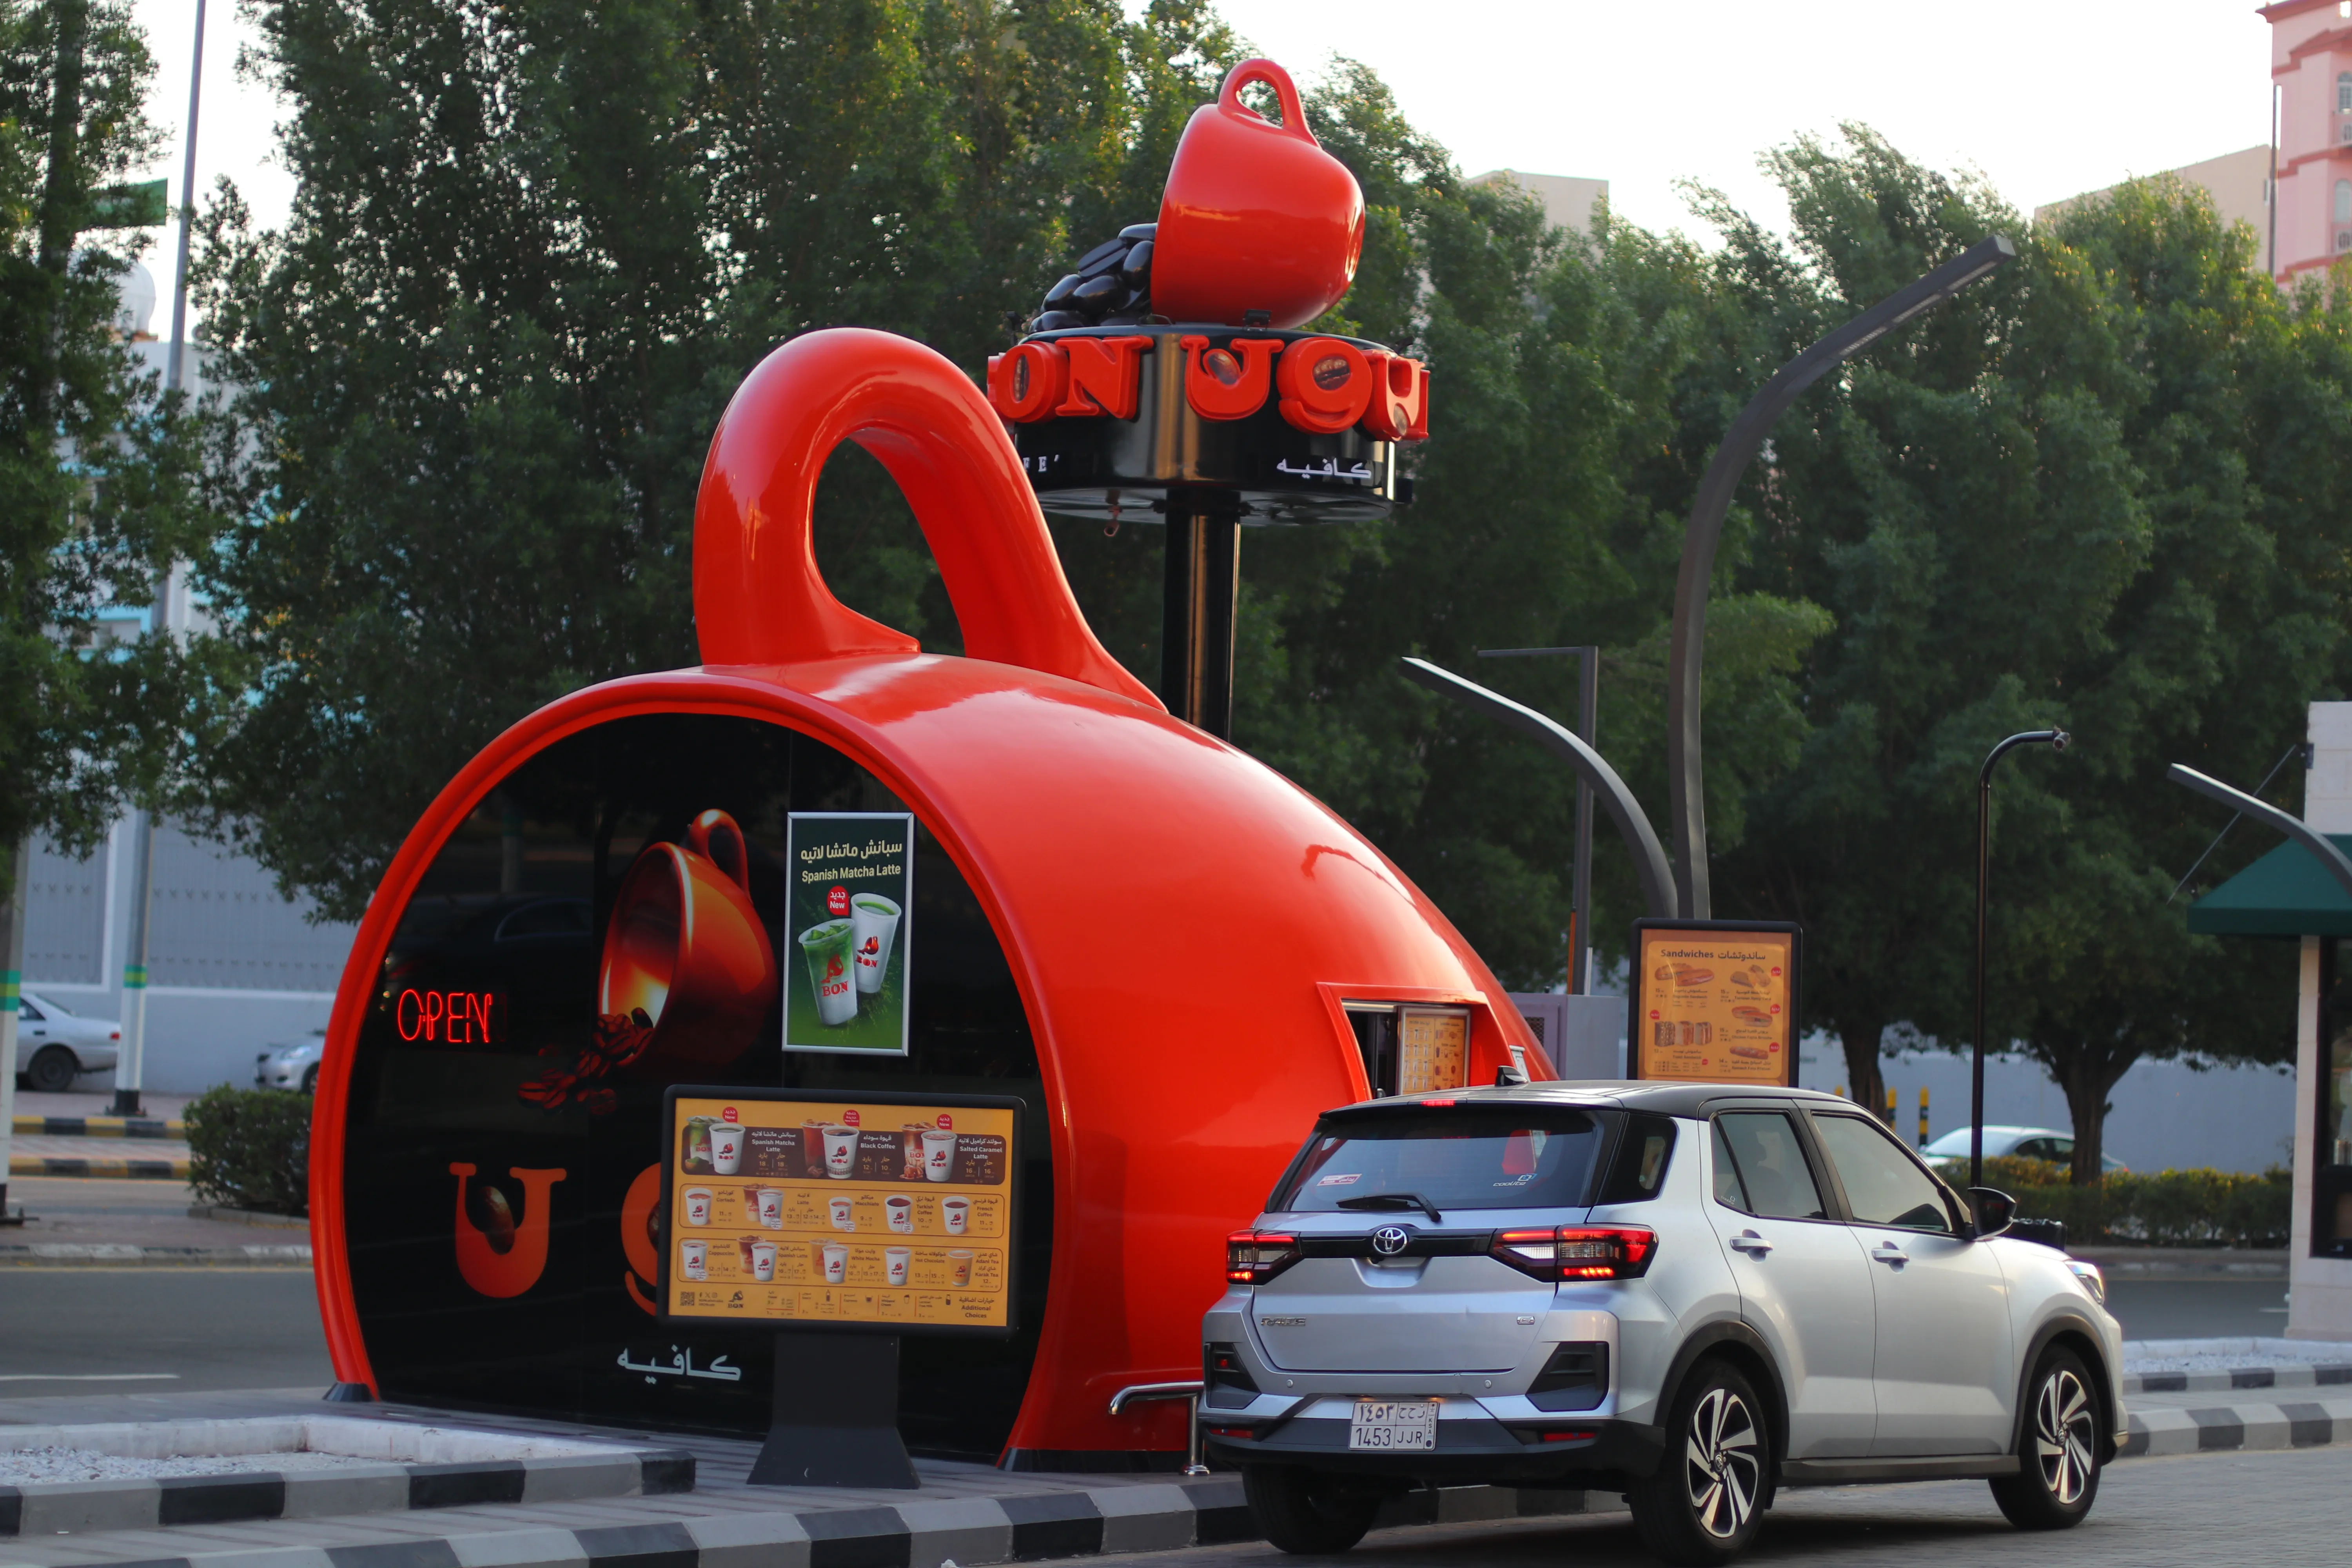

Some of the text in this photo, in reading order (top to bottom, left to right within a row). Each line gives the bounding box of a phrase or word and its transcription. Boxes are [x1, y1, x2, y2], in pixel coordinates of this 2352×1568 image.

[987, 335, 1154, 423] ON
[801, 839, 902, 863] سبانش ماتشا لاتيه
[802, 864, 900, 884] Spanish Matcha Latte
[830, 891, 845, 900] جديد
[856, 955, 878, 967] BON
[1718, 951, 1766, 961] ساندوتشات
[821, 980, 848, 996] BON
[398, 989, 493, 1044] OPEN
[616, 1344, 742, 1384] كافيه
[1356, 1428, 1422, 1446] 1453 JJR
